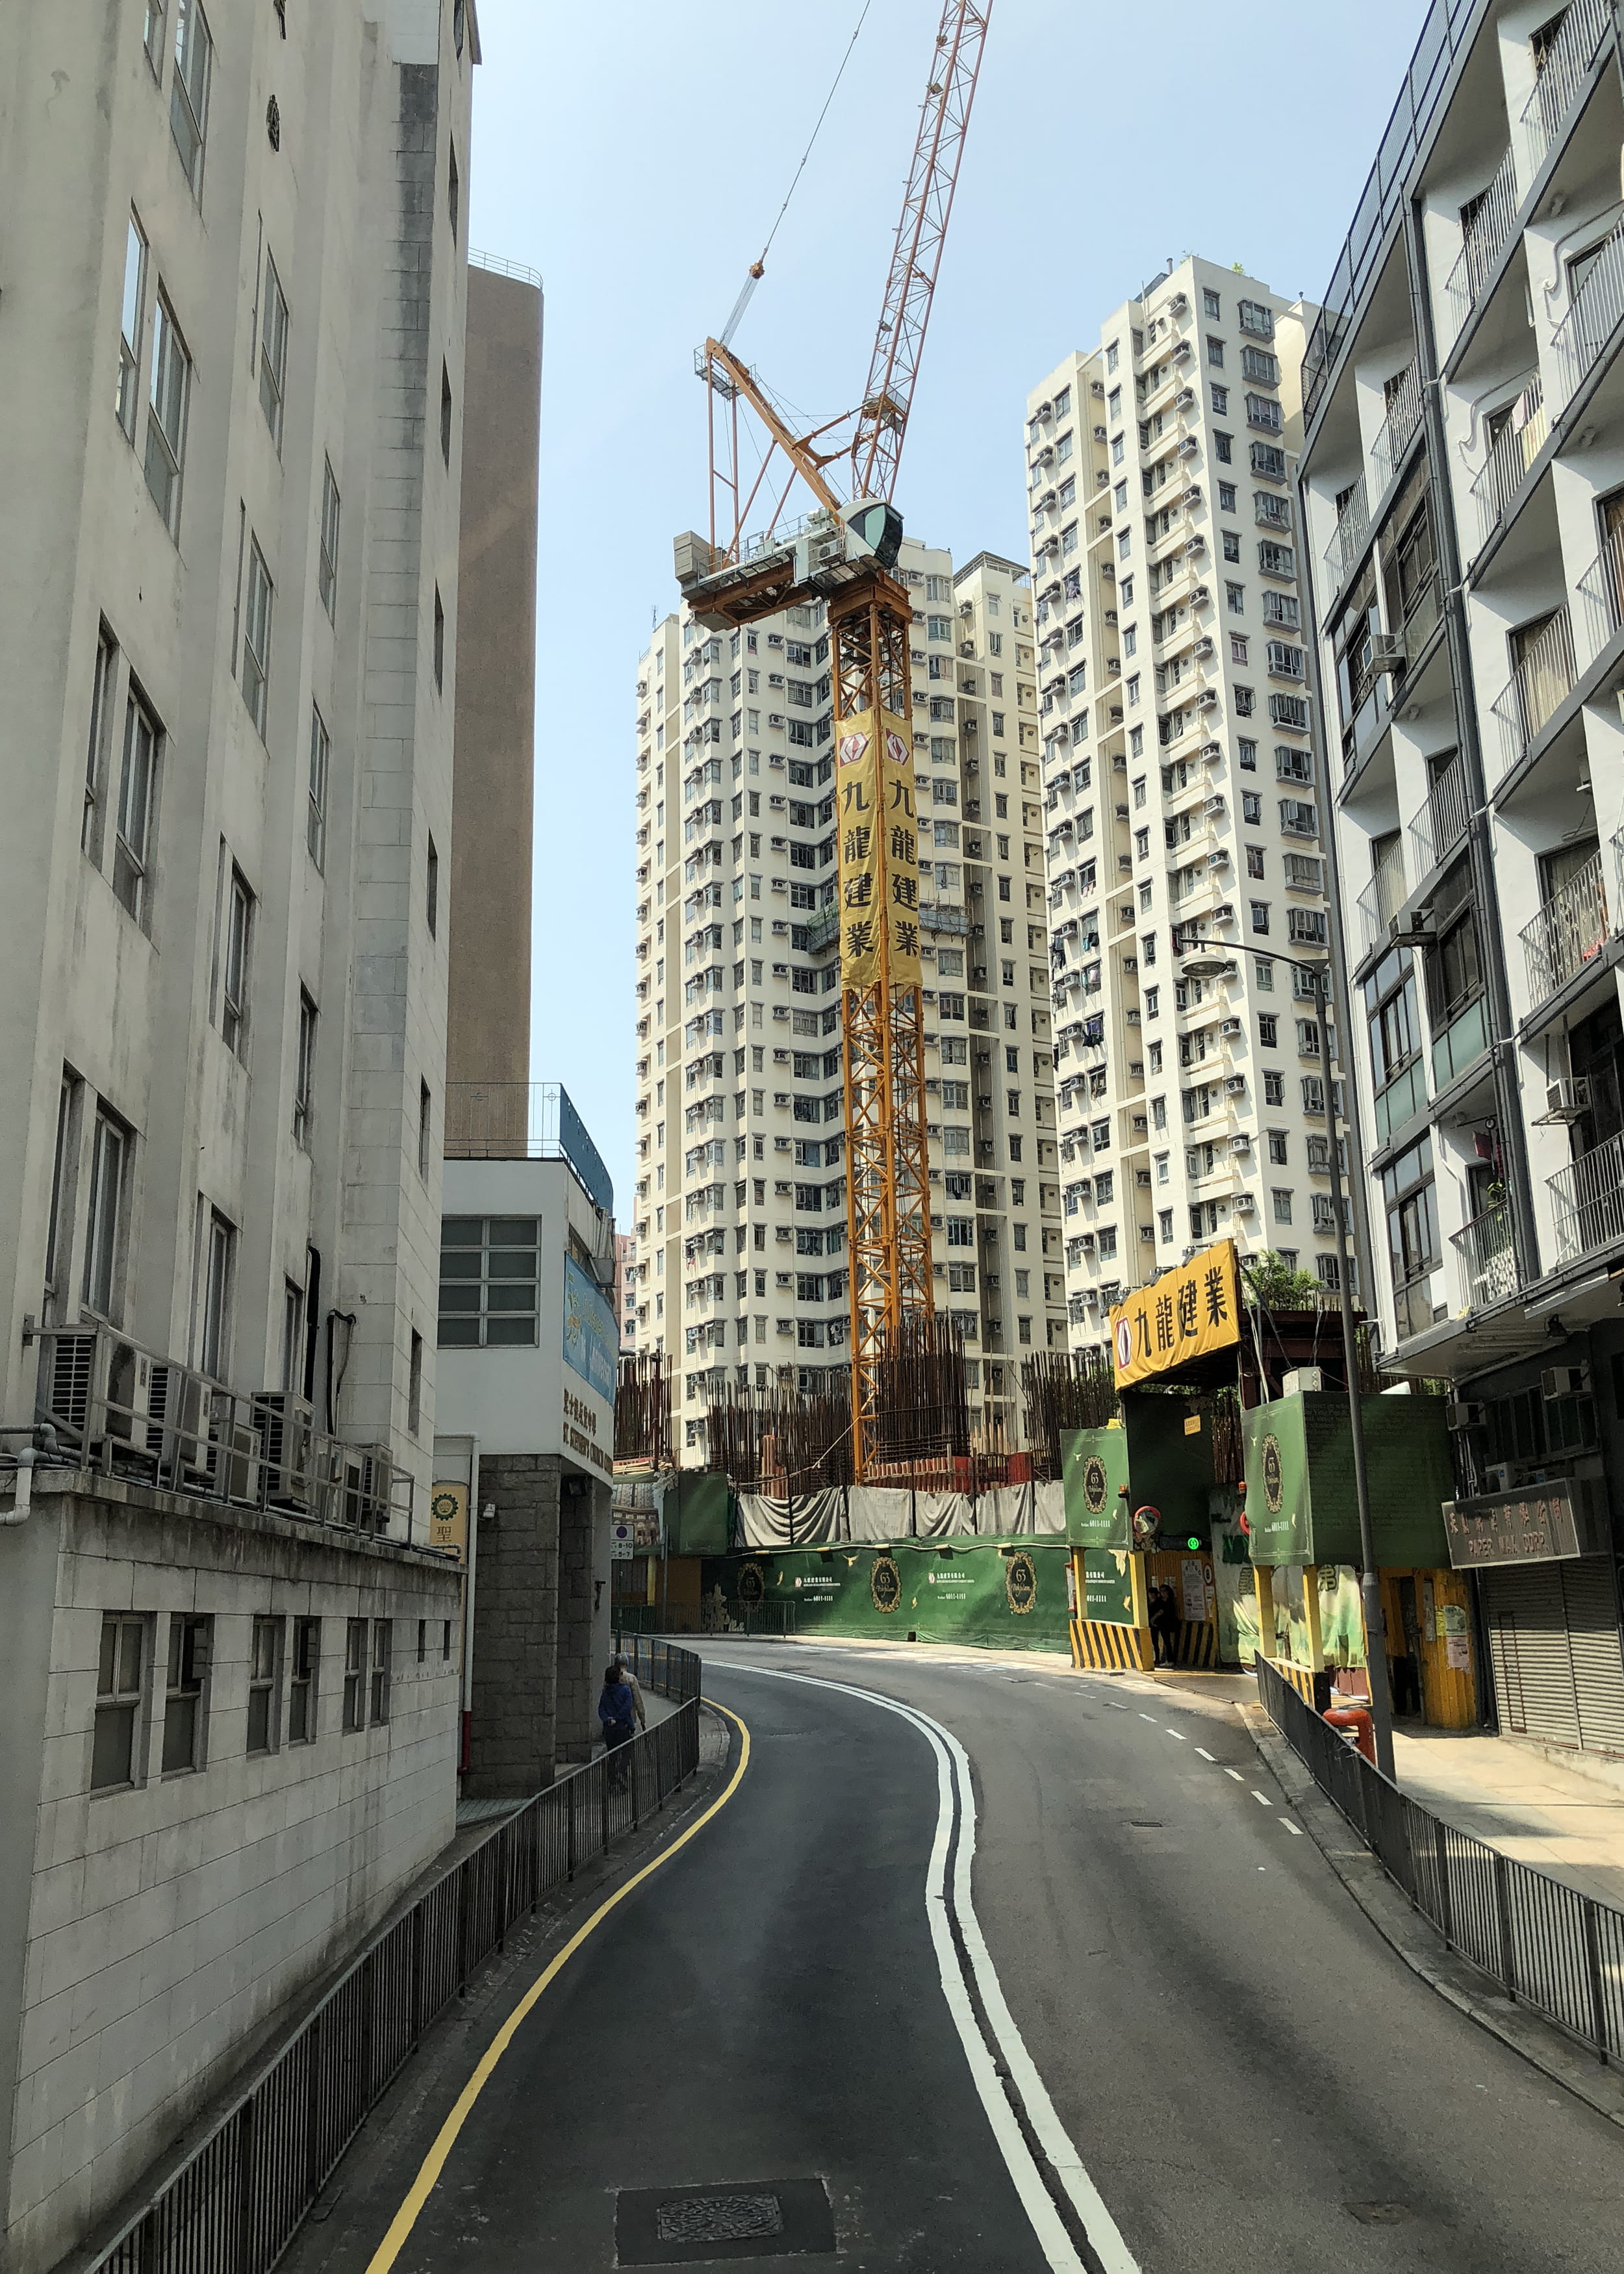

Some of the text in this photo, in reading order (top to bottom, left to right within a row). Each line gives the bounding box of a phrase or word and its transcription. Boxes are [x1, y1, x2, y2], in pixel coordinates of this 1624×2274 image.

[841, 781, 874, 958] 九龍建業
[889, 779, 920, 958] 九龍建業
[1134, 1266, 1228, 1362] 九龍建業
[1091, 1472, 1099, 1485] 63
[437, 1526, 451, 1542] 聖
[880, 1572, 890, 1584] 63
[1016, 1569, 1026, 1582] 63
